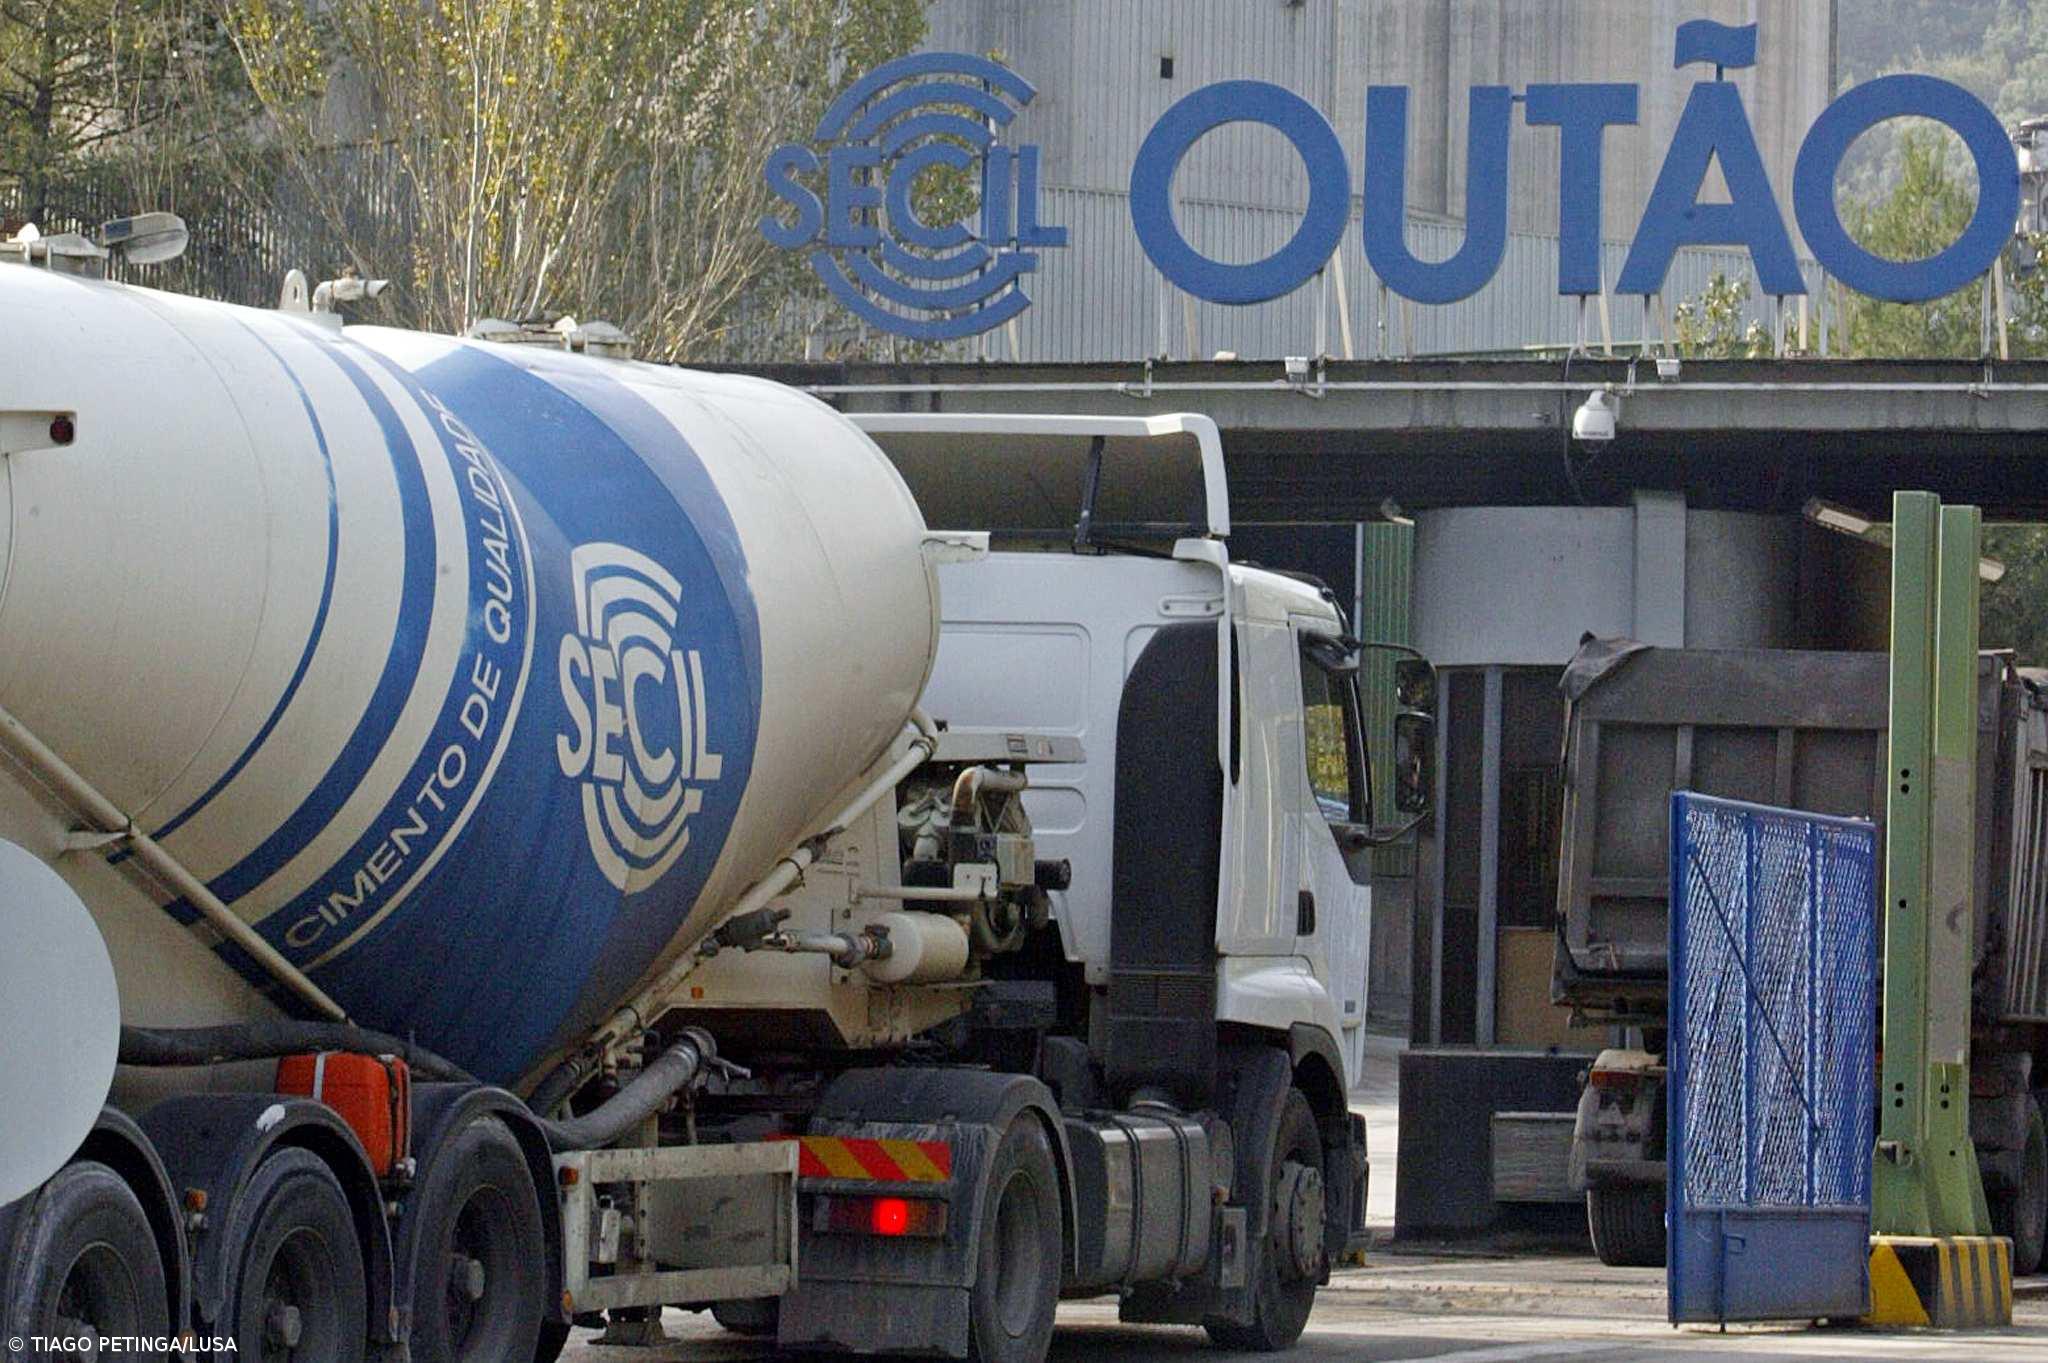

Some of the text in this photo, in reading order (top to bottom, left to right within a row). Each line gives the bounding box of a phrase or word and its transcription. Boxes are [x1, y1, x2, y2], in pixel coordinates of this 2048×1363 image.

[759, 20, 2021, 306] SECIL OUTÃO
[284, 745, 467, 948] CIMENTO
[460, 653, 503, 741] DE
[556, 632, 722, 780] SECIL
